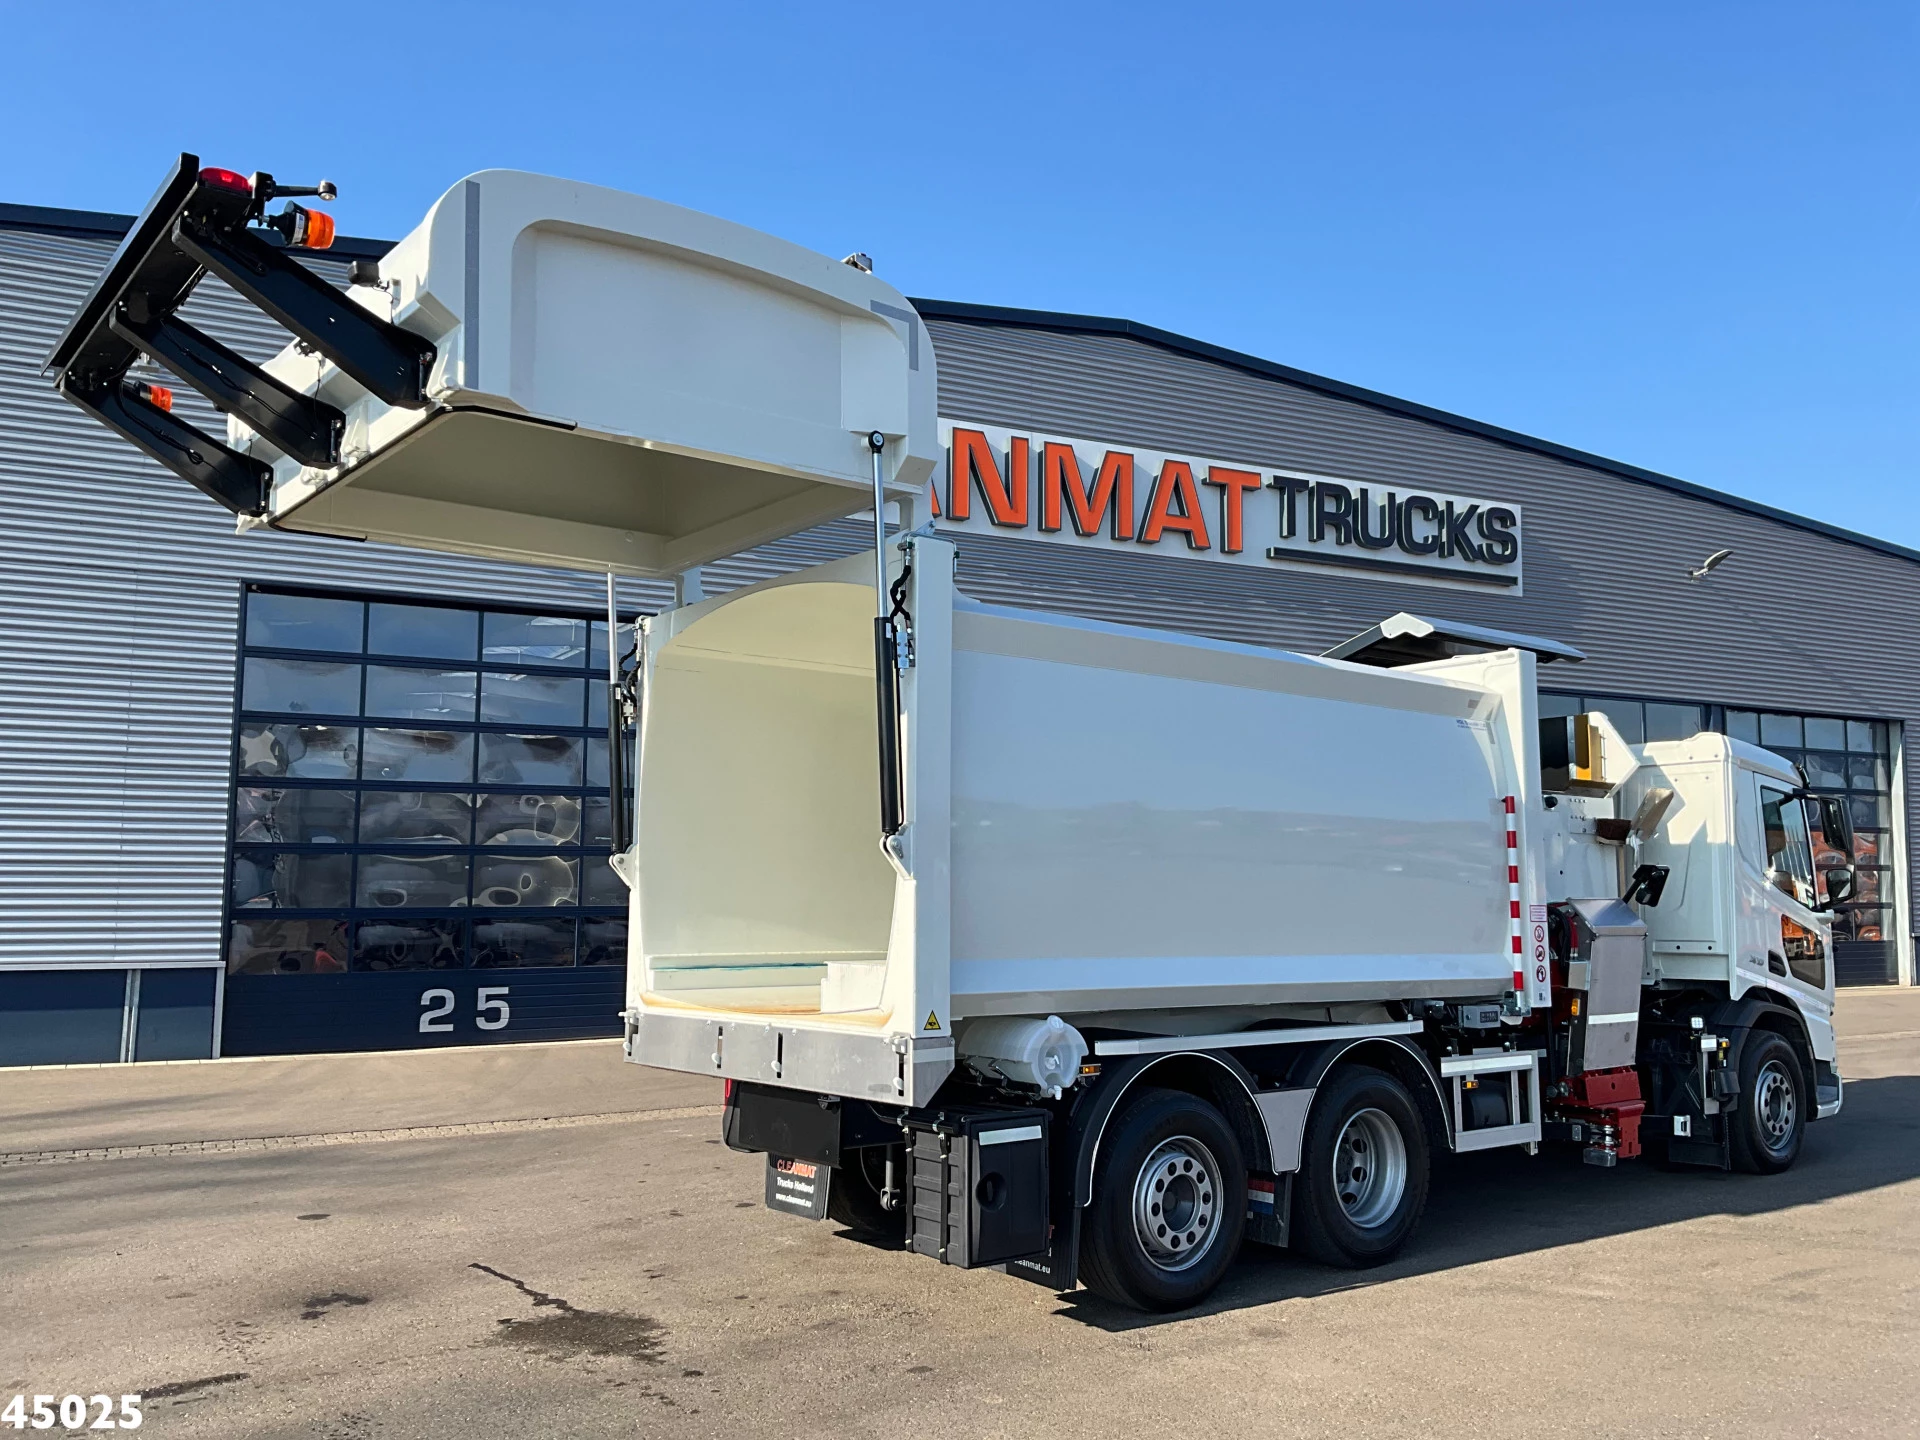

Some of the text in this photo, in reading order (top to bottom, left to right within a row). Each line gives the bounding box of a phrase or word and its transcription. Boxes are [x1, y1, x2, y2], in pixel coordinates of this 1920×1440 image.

[931, 426, 1518, 565] NMAT TRUCKS
[777, 1177, 814, 1193] Trucks Holland
